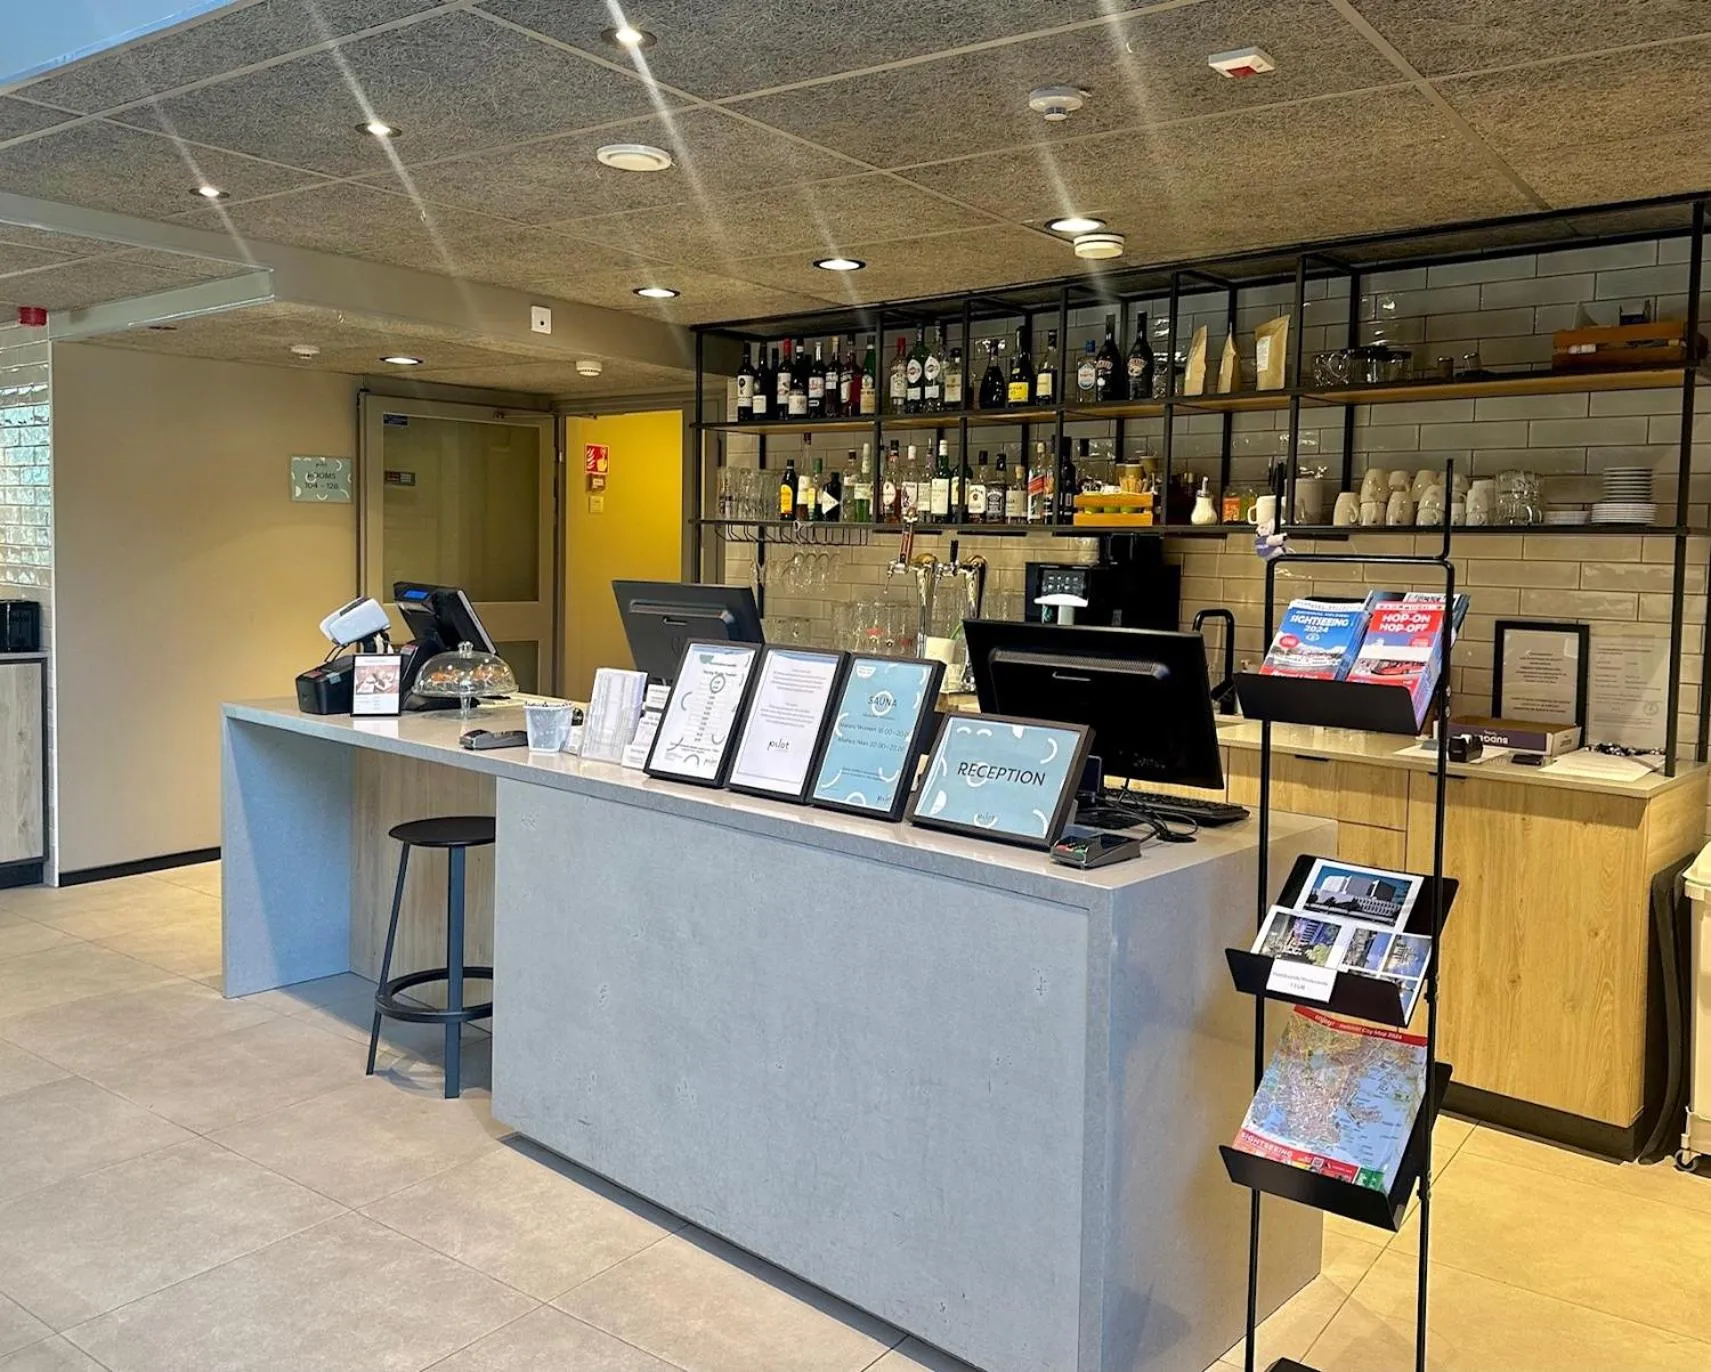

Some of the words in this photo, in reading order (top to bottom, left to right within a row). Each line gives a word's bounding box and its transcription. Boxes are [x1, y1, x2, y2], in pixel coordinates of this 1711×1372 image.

[1381, 613, 1432, 624] HOP-ON
[1303, 625, 1329, 633] 2024
[1379, 623, 1429, 633] HOP-OFF
[867, 695, 898, 708] SAUNA
[767, 739, 790, 751] pilot
[957, 761, 1046, 787] RECEPTION
